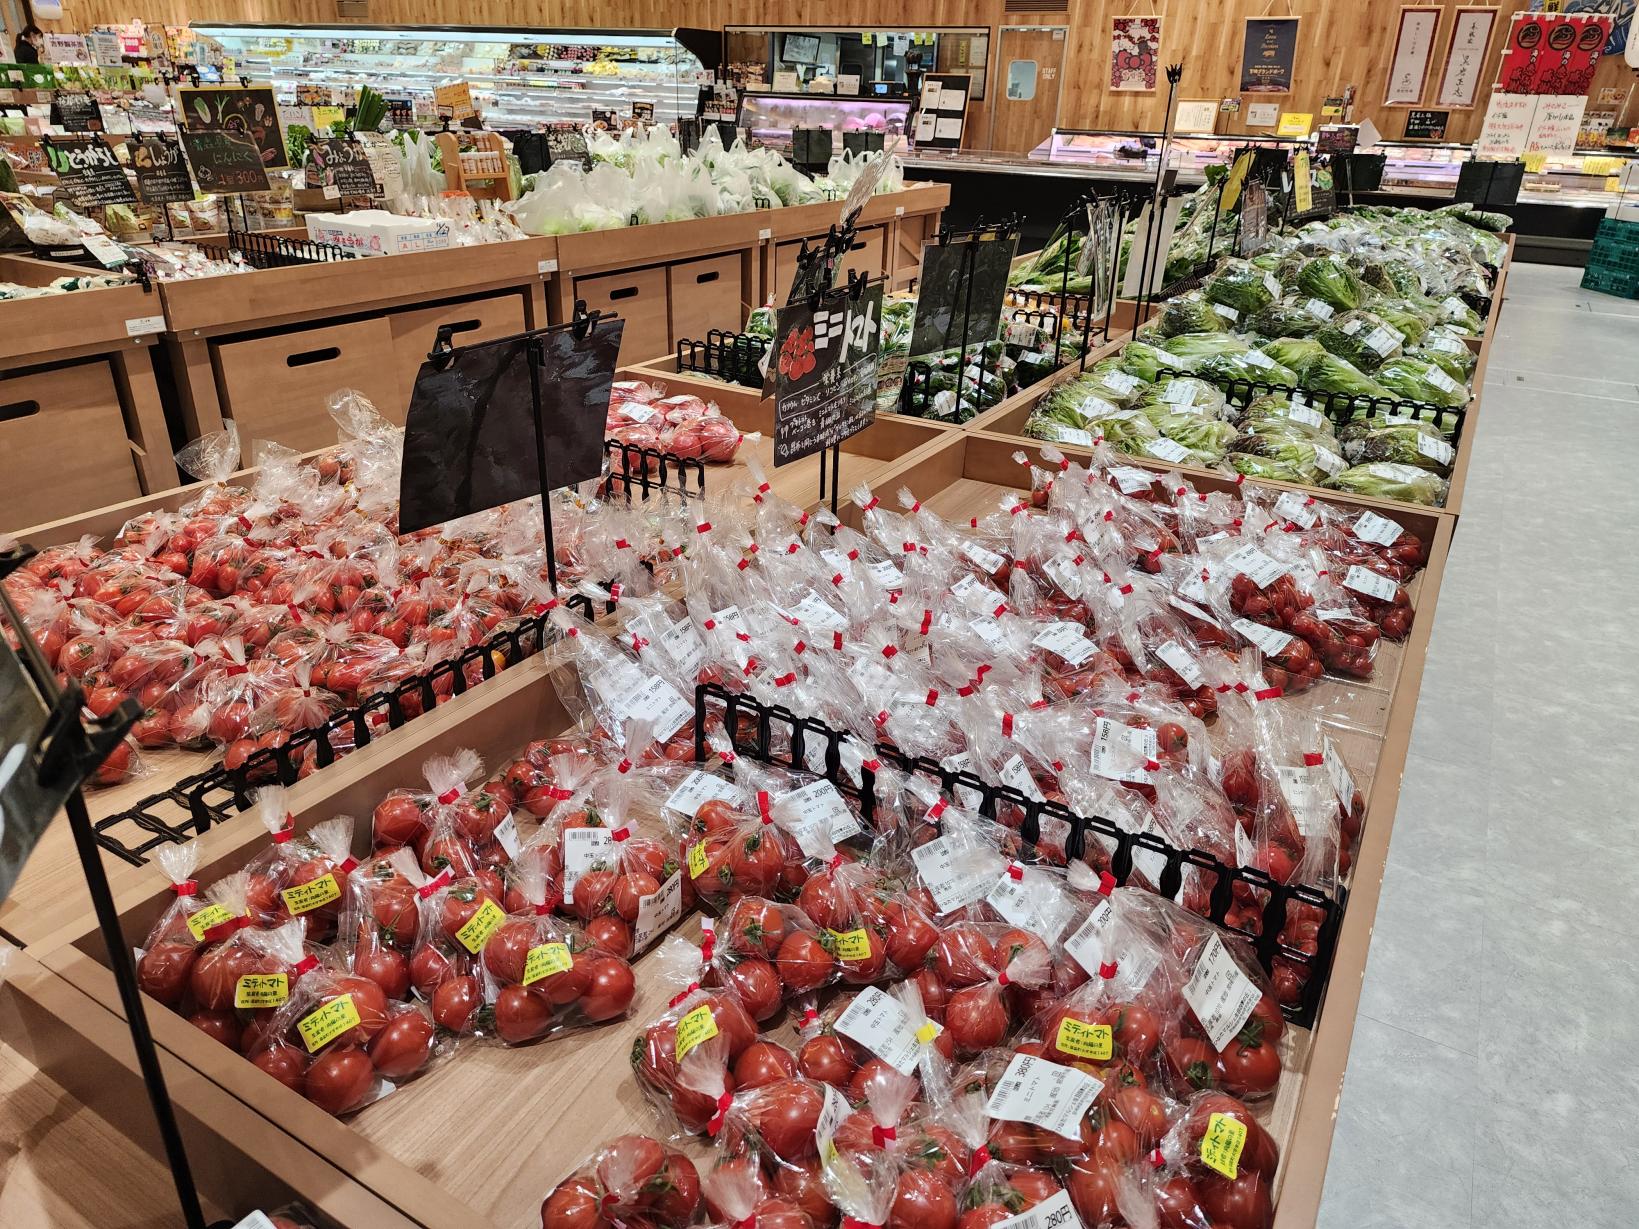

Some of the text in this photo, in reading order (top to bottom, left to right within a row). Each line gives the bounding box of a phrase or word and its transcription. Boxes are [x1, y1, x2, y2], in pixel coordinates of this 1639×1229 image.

[65, 144, 119, 169] とうがらし
[149, 146, 179, 167] しょうが
[213, 151, 253, 165] にんにく
[325, 144, 368, 165] みょうが
[1282, 169, 1320, 193] レス
[813, 300, 877, 363] ミニトマト
[1101, 721, 1111, 741] 158円
[815, 785, 834, 797] 200円
[286, 877, 332, 899] ミディトマト
[458, 902, 495, 940] ミディトマト
[522, 943, 565, 964] ディトマト
[1209, 941, 1222, 965] 170円
[242, 977, 284, 987] ミディトマト
[867, 989, 883, 1008] 280円
[300, 998, 351, 1031] ミディトマト
[1063, 1020, 1110, 1039] ミディトマト
[1015, 1056, 1036, 1078] 380円
[1024, 1076, 1041, 1104] ミニトマト
[1201, 1116, 1230, 1162] ミディトマト
[1045, 1204, 1072, 1229] 280円
